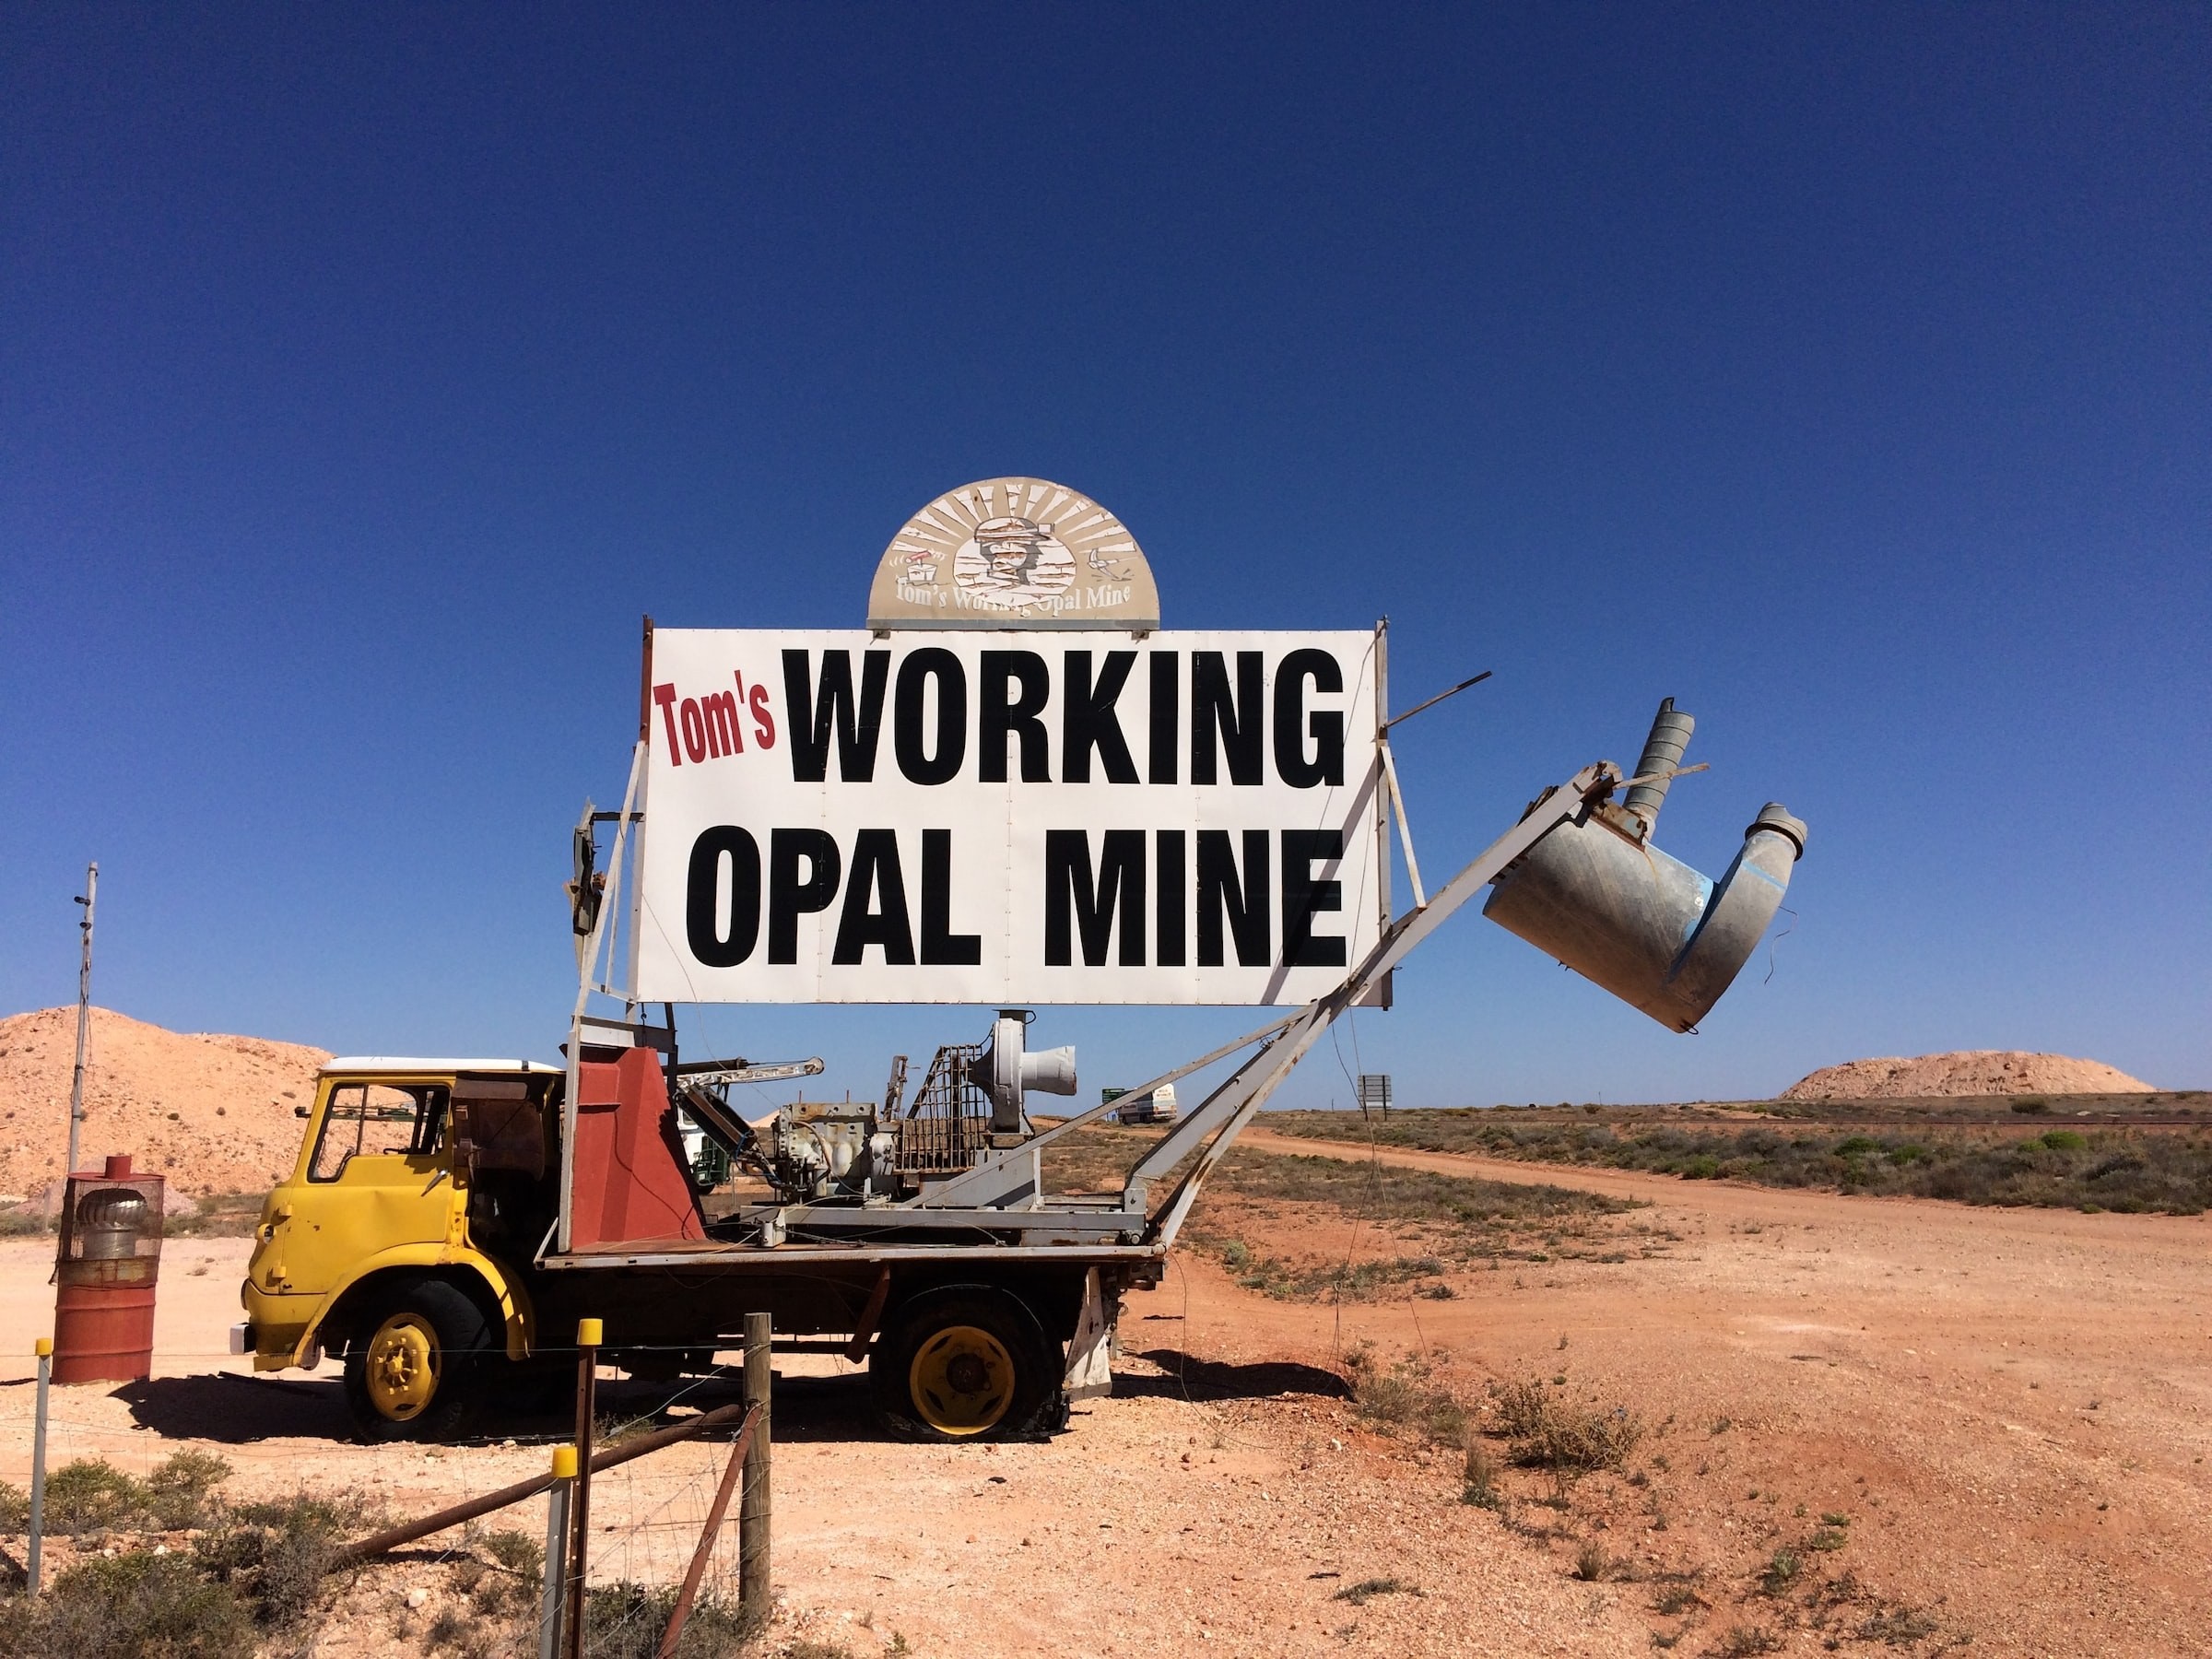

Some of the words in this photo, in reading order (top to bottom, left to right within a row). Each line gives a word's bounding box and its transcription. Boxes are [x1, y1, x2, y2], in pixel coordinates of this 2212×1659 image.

[1086, 583, 1131, 609] Mine
[652, 669, 776, 768] Tom's
[781, 647, 1345, 789] WORKING
[686, 825, 982, 968] OPAL
[1044, 829, 1347, 968] MINE
